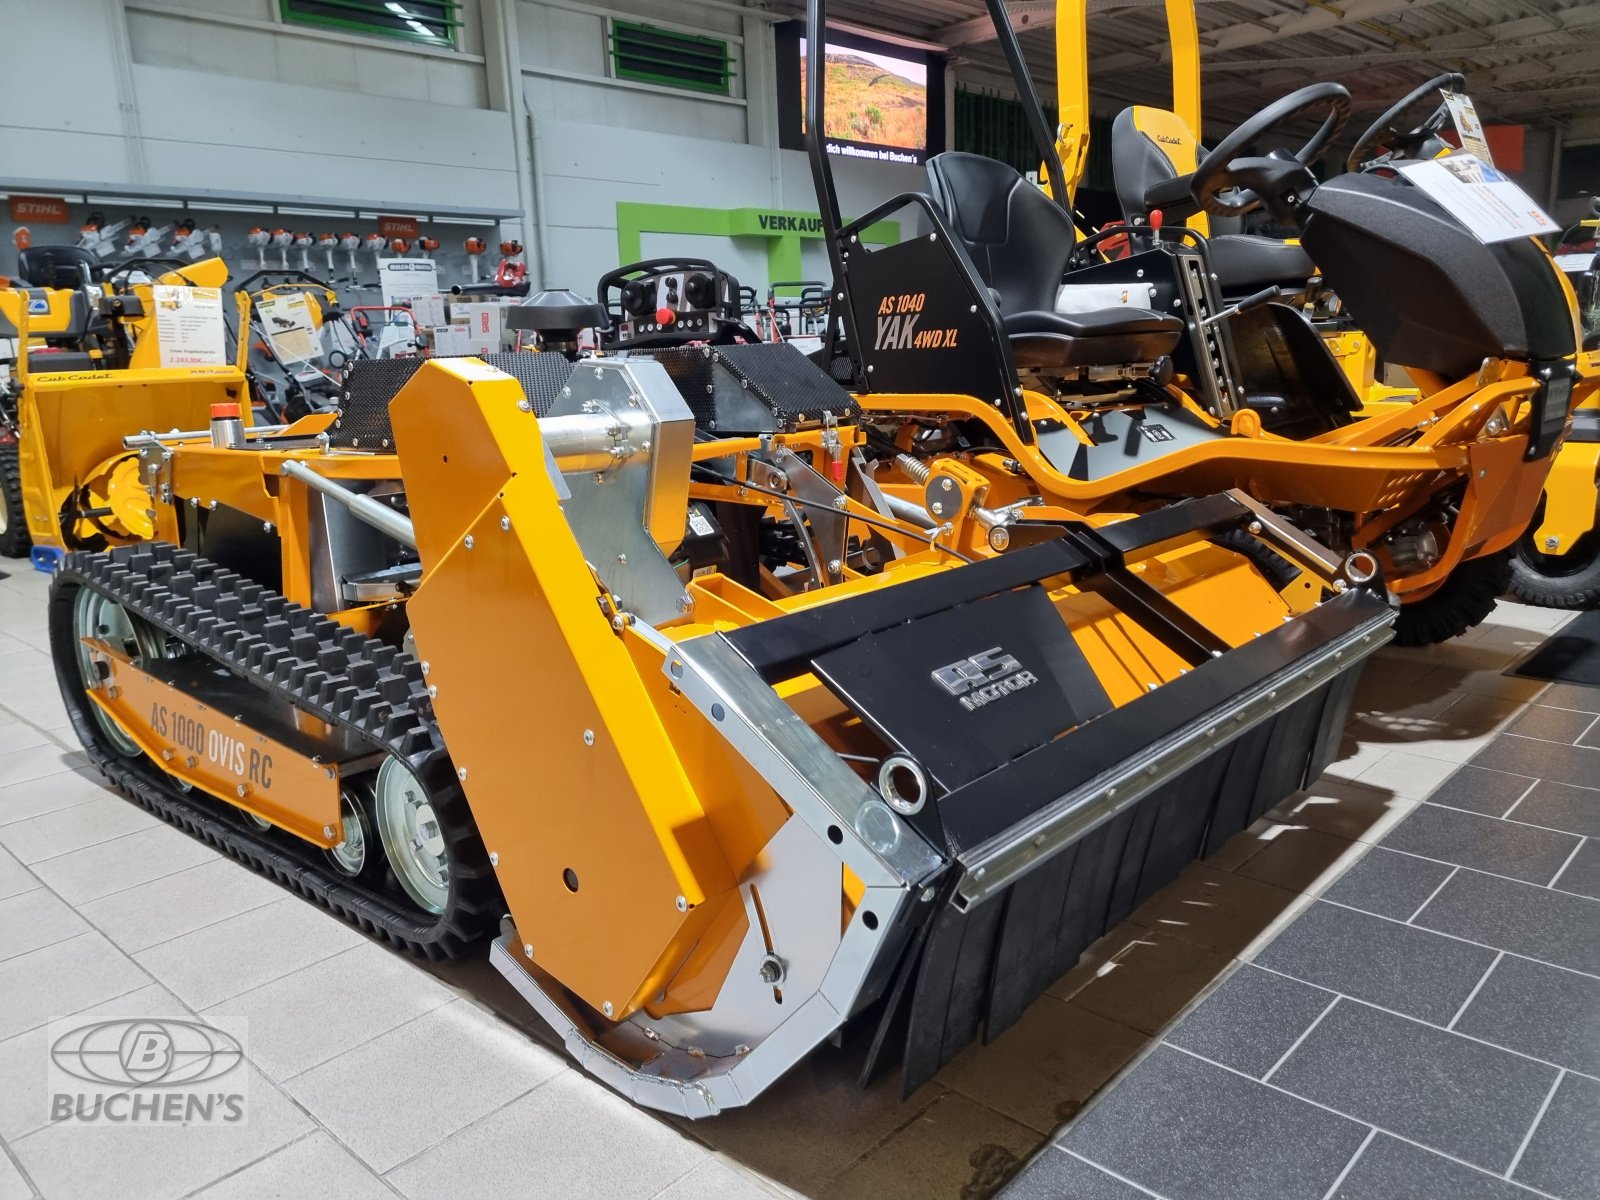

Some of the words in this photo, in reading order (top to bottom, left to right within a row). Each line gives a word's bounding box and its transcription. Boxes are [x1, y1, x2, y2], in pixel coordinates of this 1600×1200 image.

[841, 145, 878, 159] willkommen
[878, 150, 889, 160] bei
[16, 202, 63, 215] STIHL
[383, 222, 414, 233] STIHL
[878, 296, 895, 315] AS
[896, 293, 926, 314] 1040
[874, 313, 920, 350] YAK
[914, 329, 943, 349] 4WD
[942, 328, 958, 348] XL
[959, 671, 1039, 711] MOTOR
[151, 702, 168, 737] AS
[171, 711, 205, 756] 1000
[208, 729, 246, 776] OVIS
[248, 747, 273, 789] RC
